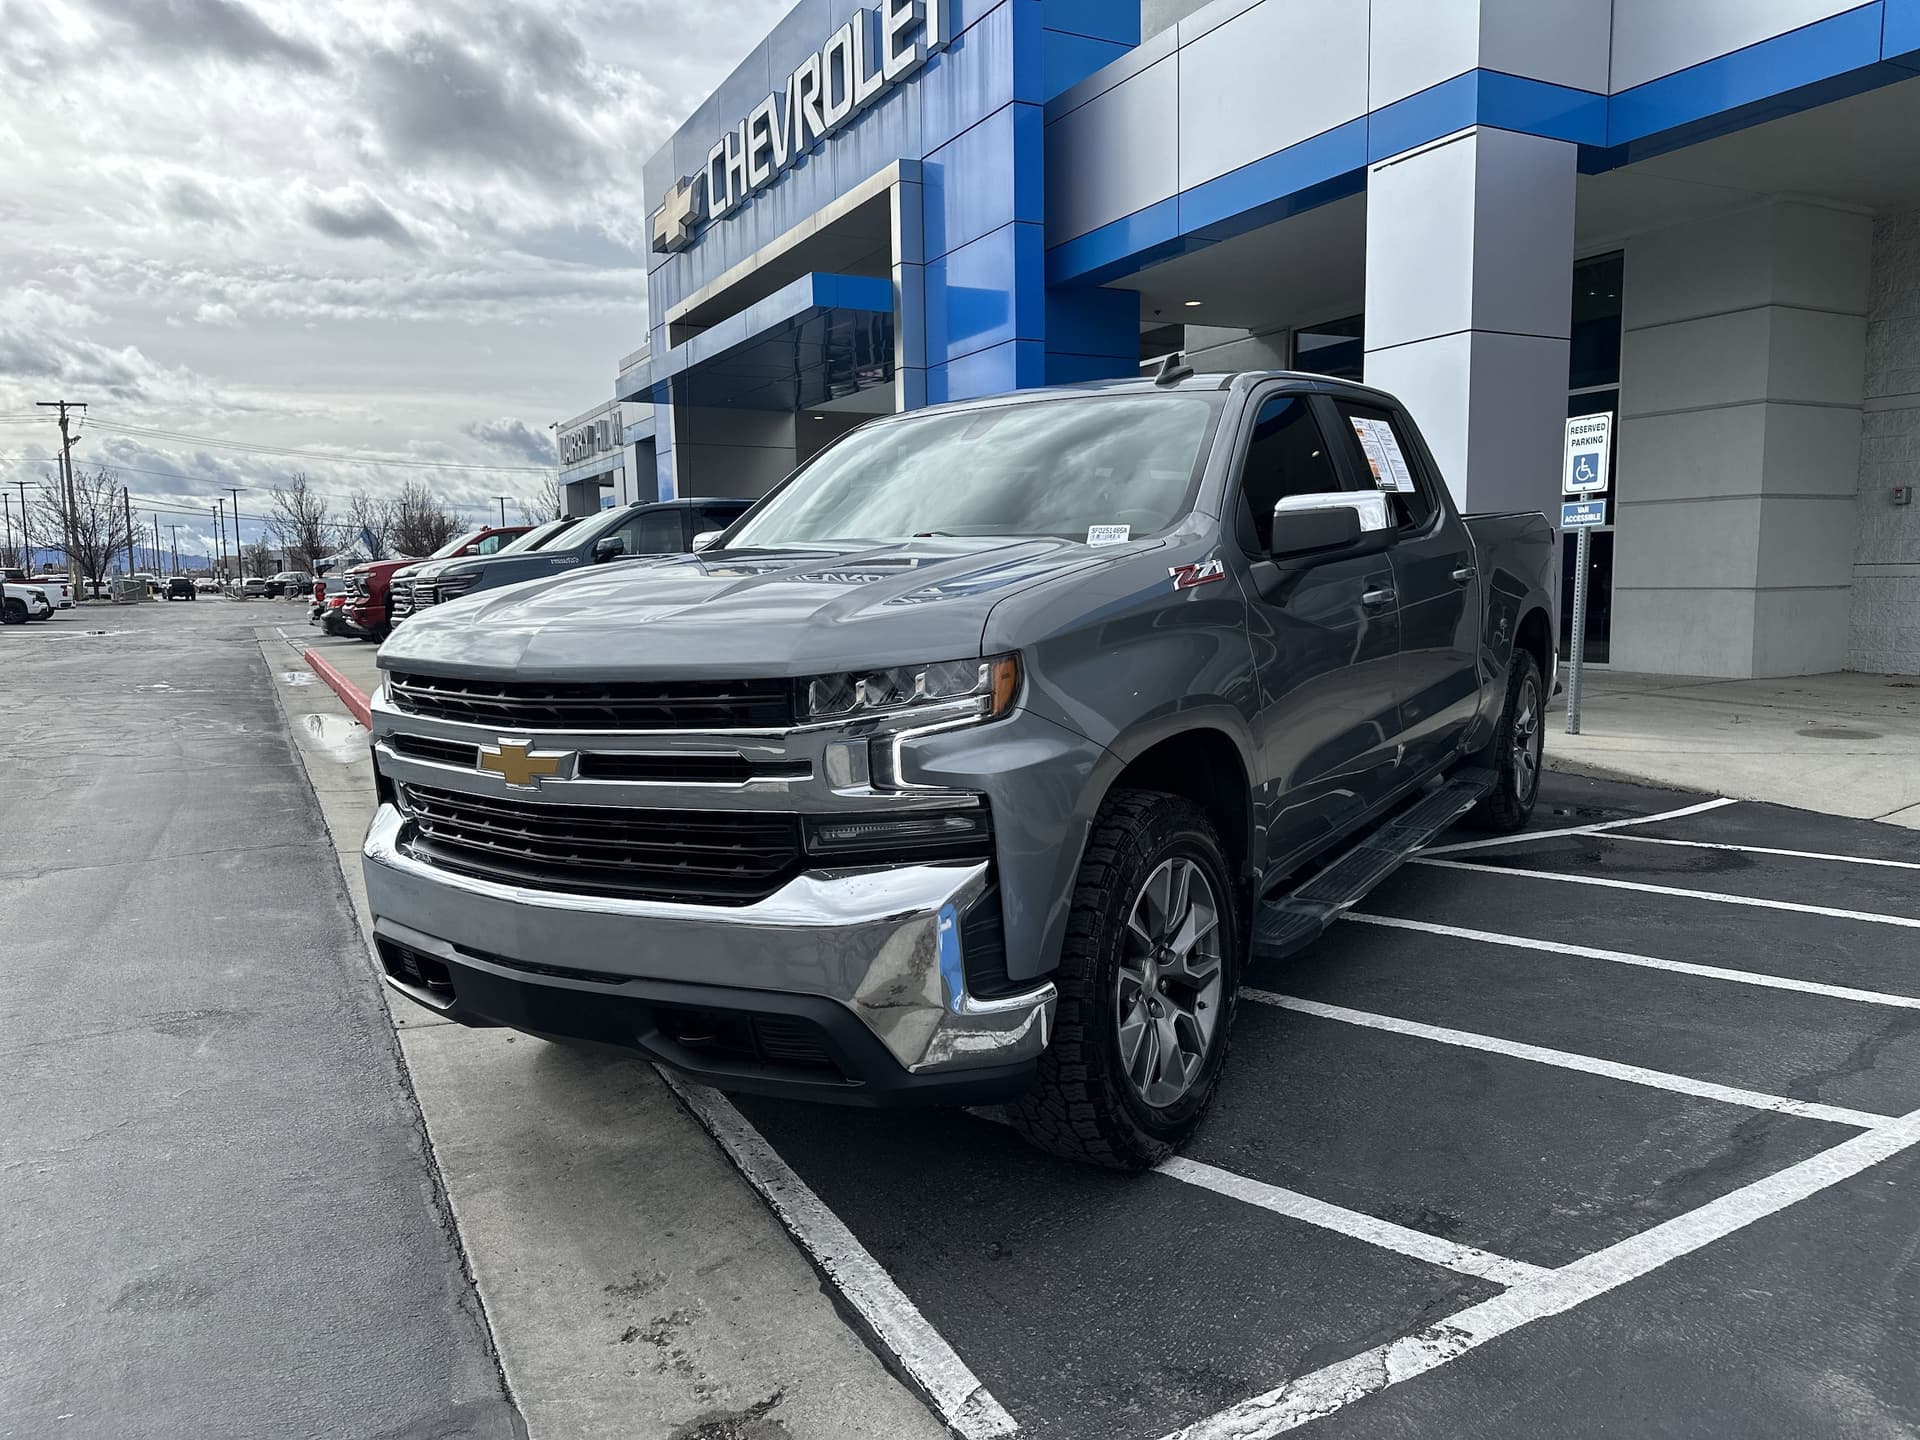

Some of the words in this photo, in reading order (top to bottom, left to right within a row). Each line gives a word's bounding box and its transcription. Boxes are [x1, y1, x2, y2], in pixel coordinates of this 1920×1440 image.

[1571, 423, 1606, 435] RESERVED
[1572, 436, 1604, 447] PARKING
[1564, 513, 1601, 523] ACCESSIBLE
[1168, 560, 1225, 591] Z71
